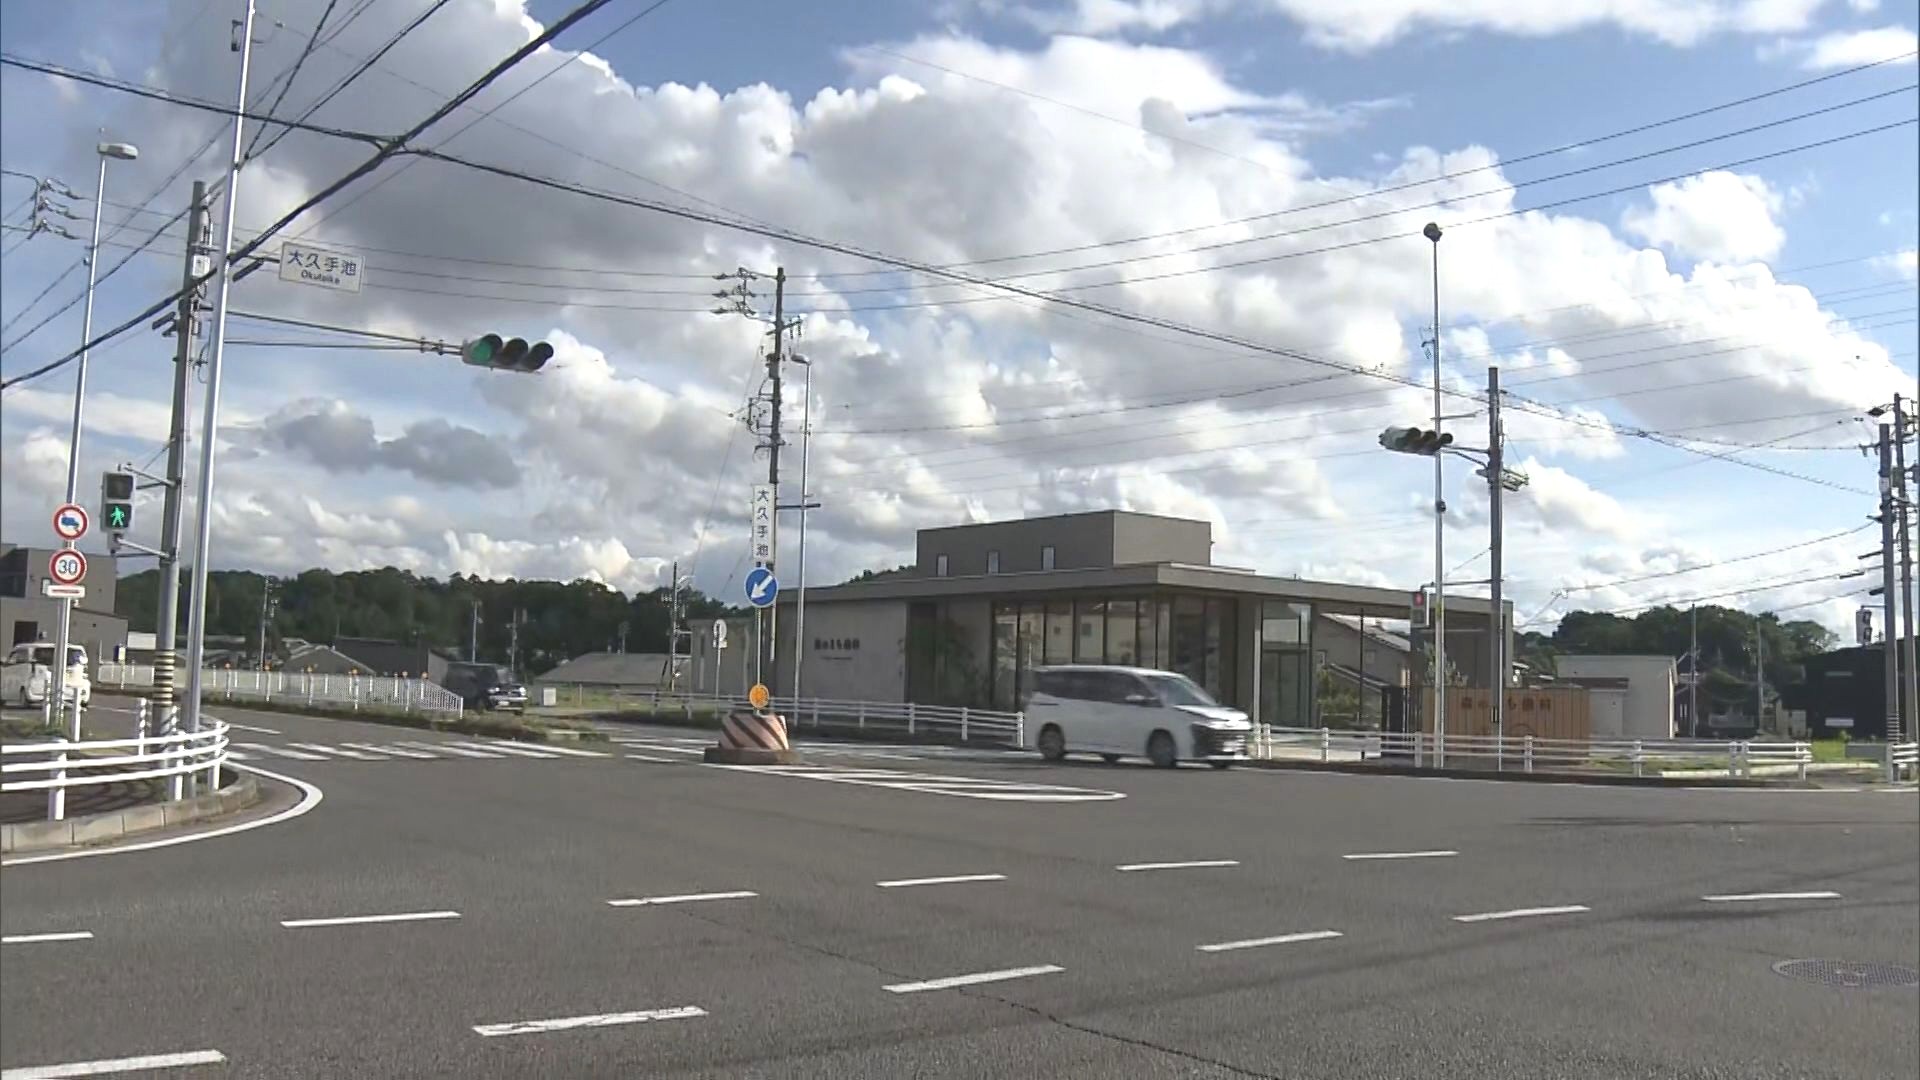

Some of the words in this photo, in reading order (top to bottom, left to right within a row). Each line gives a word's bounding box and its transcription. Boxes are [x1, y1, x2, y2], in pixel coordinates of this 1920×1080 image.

[287, 249, 357, 276] 大久手池
[755, 489, 769, 557] 大久手池
[58, 559, 78, 575] 30
